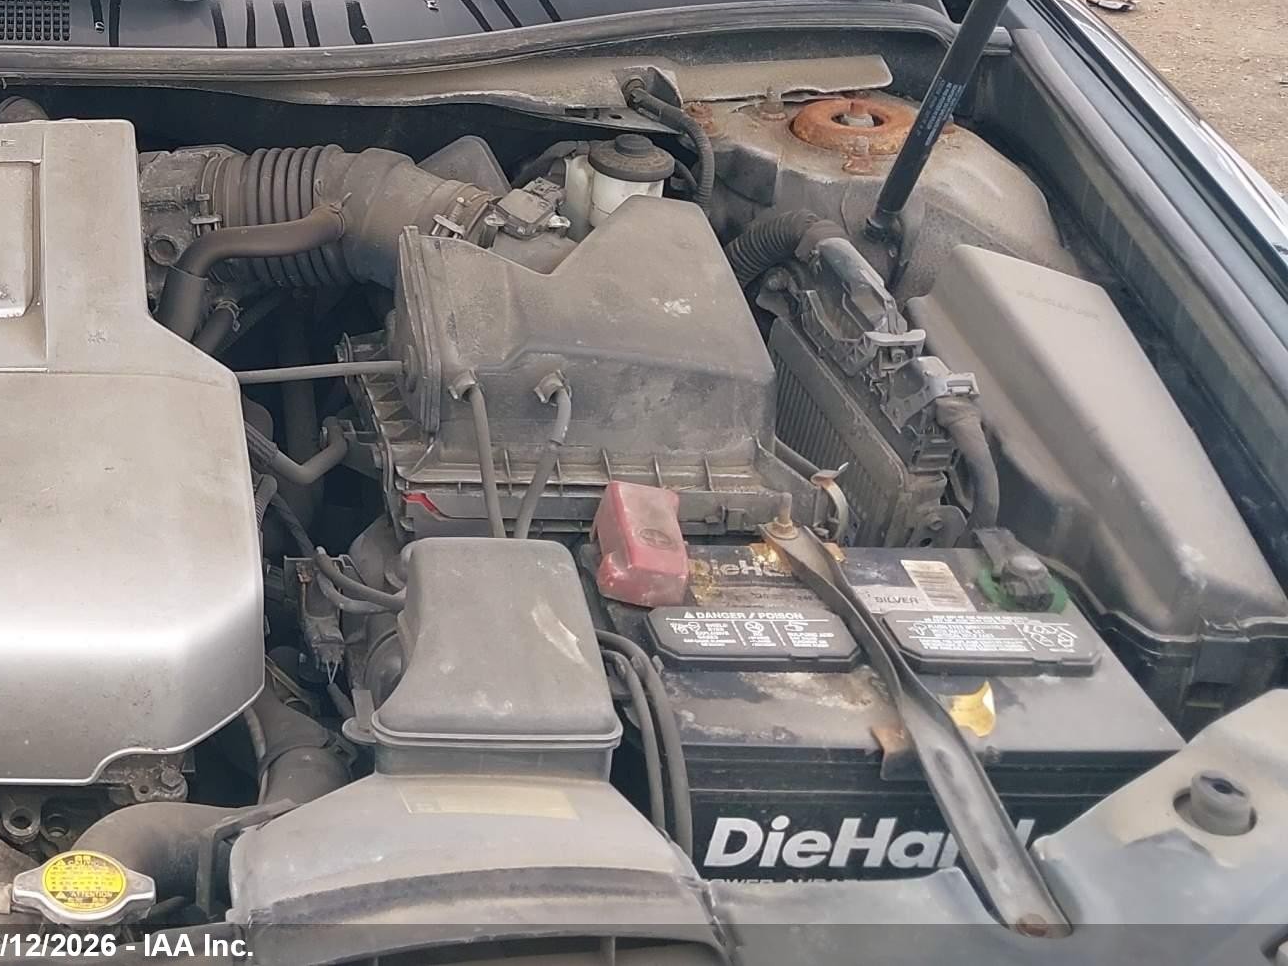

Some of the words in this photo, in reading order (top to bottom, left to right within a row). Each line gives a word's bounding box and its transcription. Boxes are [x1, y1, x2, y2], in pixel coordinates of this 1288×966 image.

[874, 595, 919, 604] SILVER
[695, 611, 747, 620] DANGER
[759, 611, 804, 620] POISON
